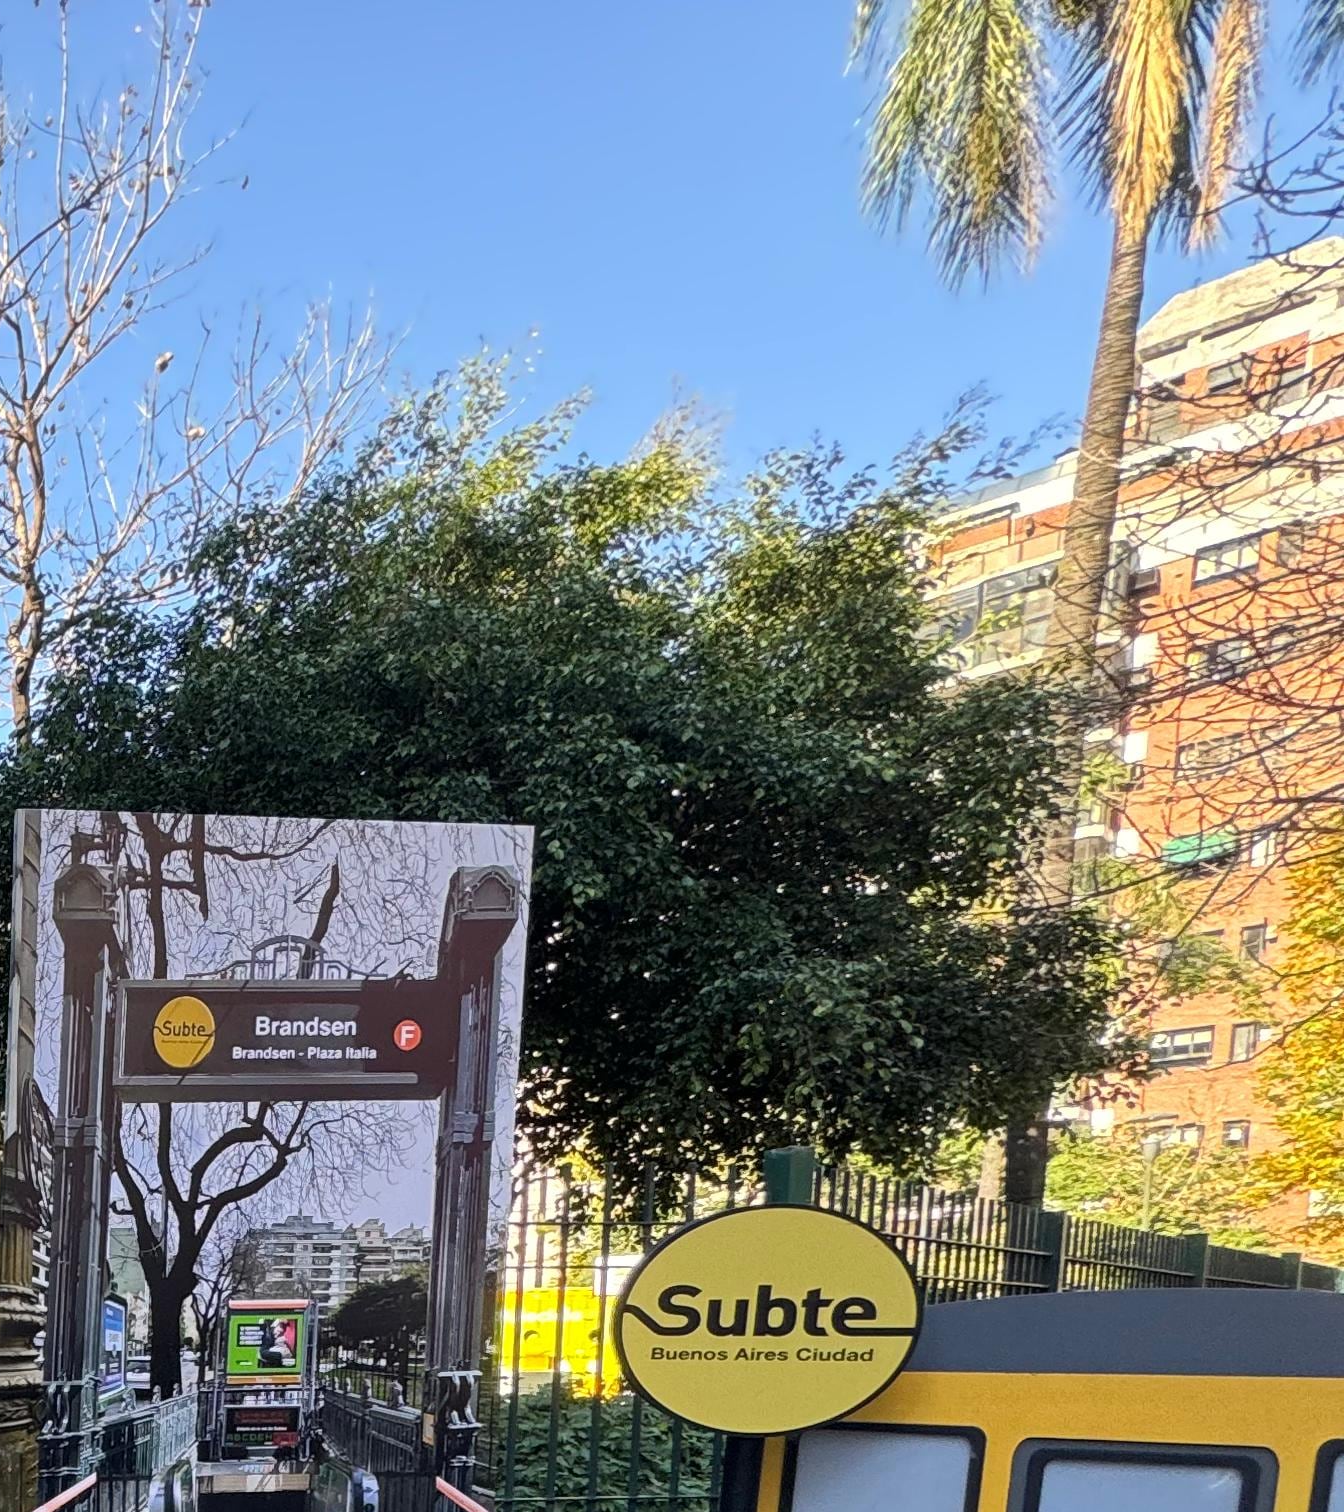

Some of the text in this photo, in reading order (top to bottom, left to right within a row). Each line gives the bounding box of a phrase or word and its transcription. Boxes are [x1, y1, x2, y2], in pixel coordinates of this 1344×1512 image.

[159, 1020, 210, 1036] Subte
[255, 1016, 357, 1036] Brandsen
[400, 1025, 416, 1047] F
[232, 1047, 296, 1060] Brandsen
[307, 1047, 343, 1060] Plaza
[345, 1047, 378, 1060] Italia
[647, 1284, 902, 1338] Subte
[650, 1347, 874, 1362] Buenos Aires Ciudad
